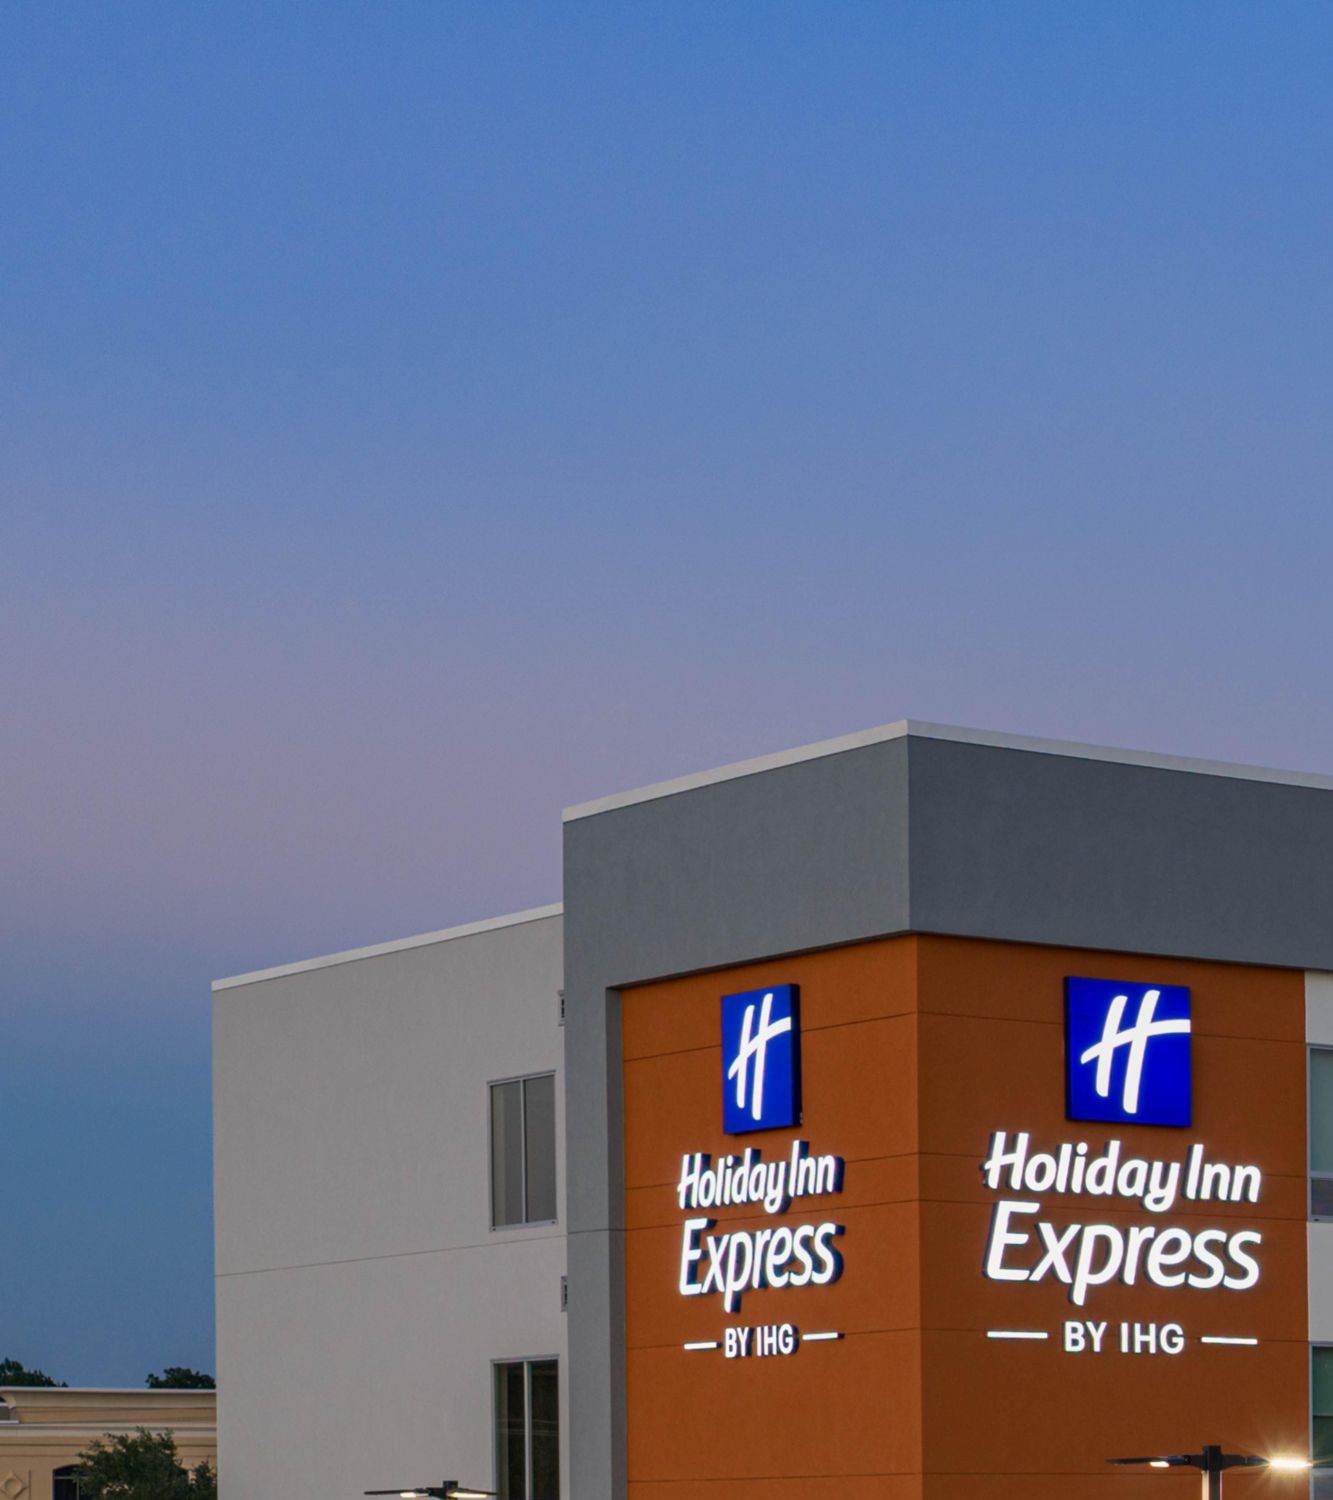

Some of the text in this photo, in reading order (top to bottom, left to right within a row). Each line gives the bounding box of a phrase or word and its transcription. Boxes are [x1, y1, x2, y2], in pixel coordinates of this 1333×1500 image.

[677, 1140, 835, 1214] Holiday Inn
[984, 1131, 1262, 1212] Holiday Inn
[679, 1217, 837, 1314] Express
[986, 1200, 1262, 1306] Express
[724, 1323, 795, 1359] BY IHG
[1063, 1320, 1185, 1354] BY IHG
